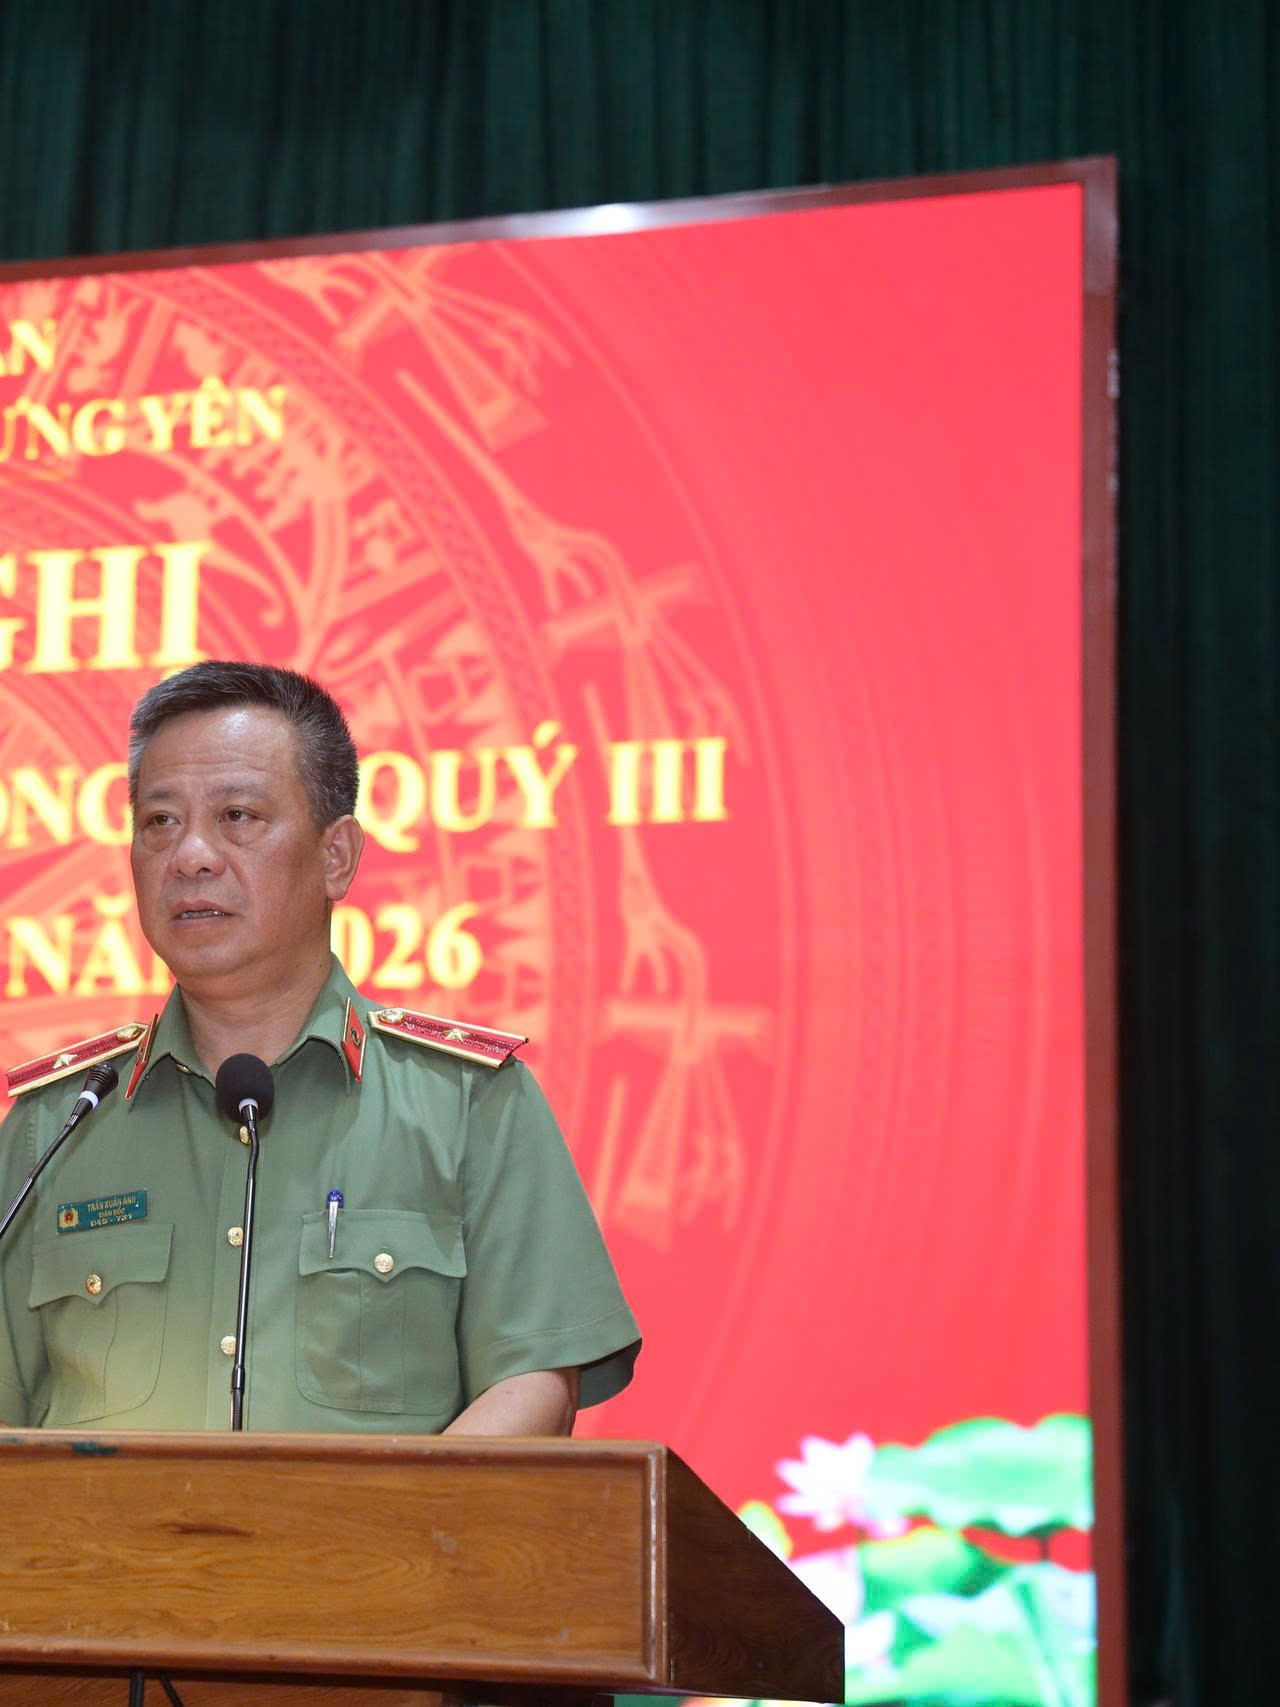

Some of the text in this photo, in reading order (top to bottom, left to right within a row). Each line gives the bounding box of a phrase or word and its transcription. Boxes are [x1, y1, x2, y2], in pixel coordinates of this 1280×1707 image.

[137, 374, 289, 454] YÊN
[353, 721, 576, 853] QUÝ
[608, 737, 726, 827] III
[6, 892, 171, 999] NĂ
[329, 902, 483, 990] 026
